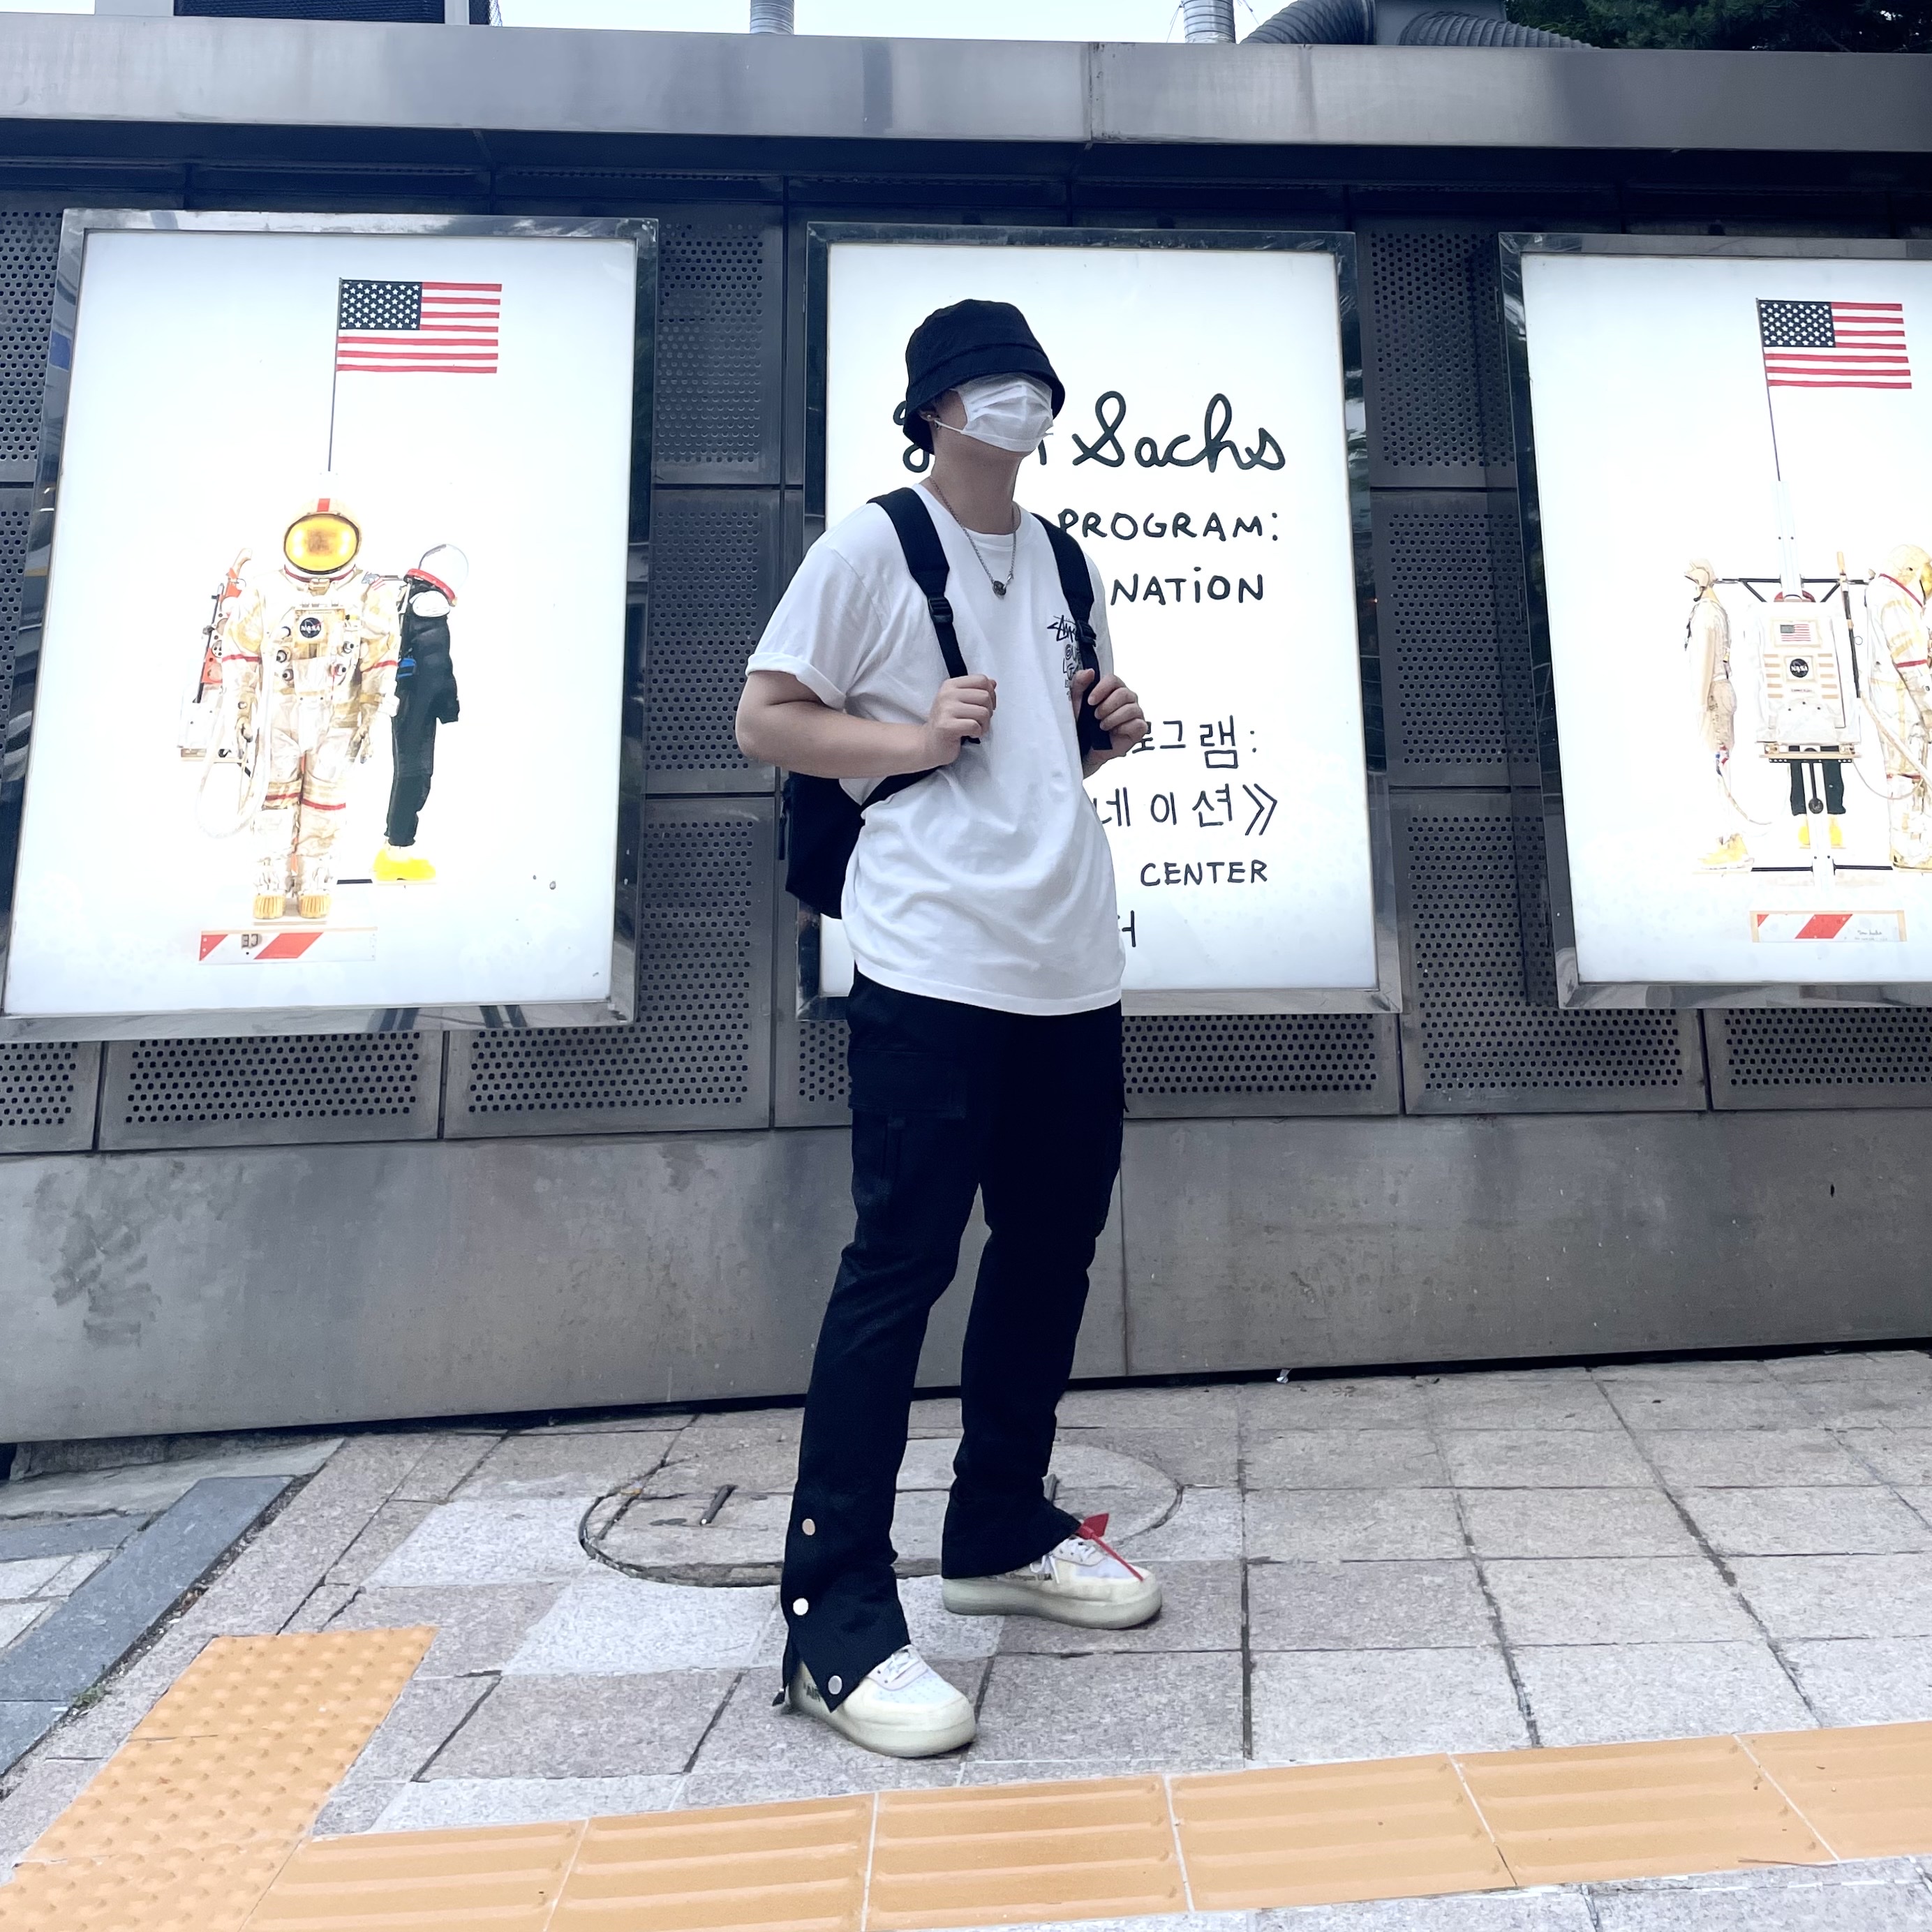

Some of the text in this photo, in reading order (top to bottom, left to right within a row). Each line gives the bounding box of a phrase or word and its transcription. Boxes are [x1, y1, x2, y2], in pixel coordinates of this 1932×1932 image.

[1071, 390, 1286, 473] Sachs
[1057, 507, 1278, 542] PROGRAM:
[1110, 566, 1263, 606] NATION
[1140, 859, 1268, 887] CENTER
